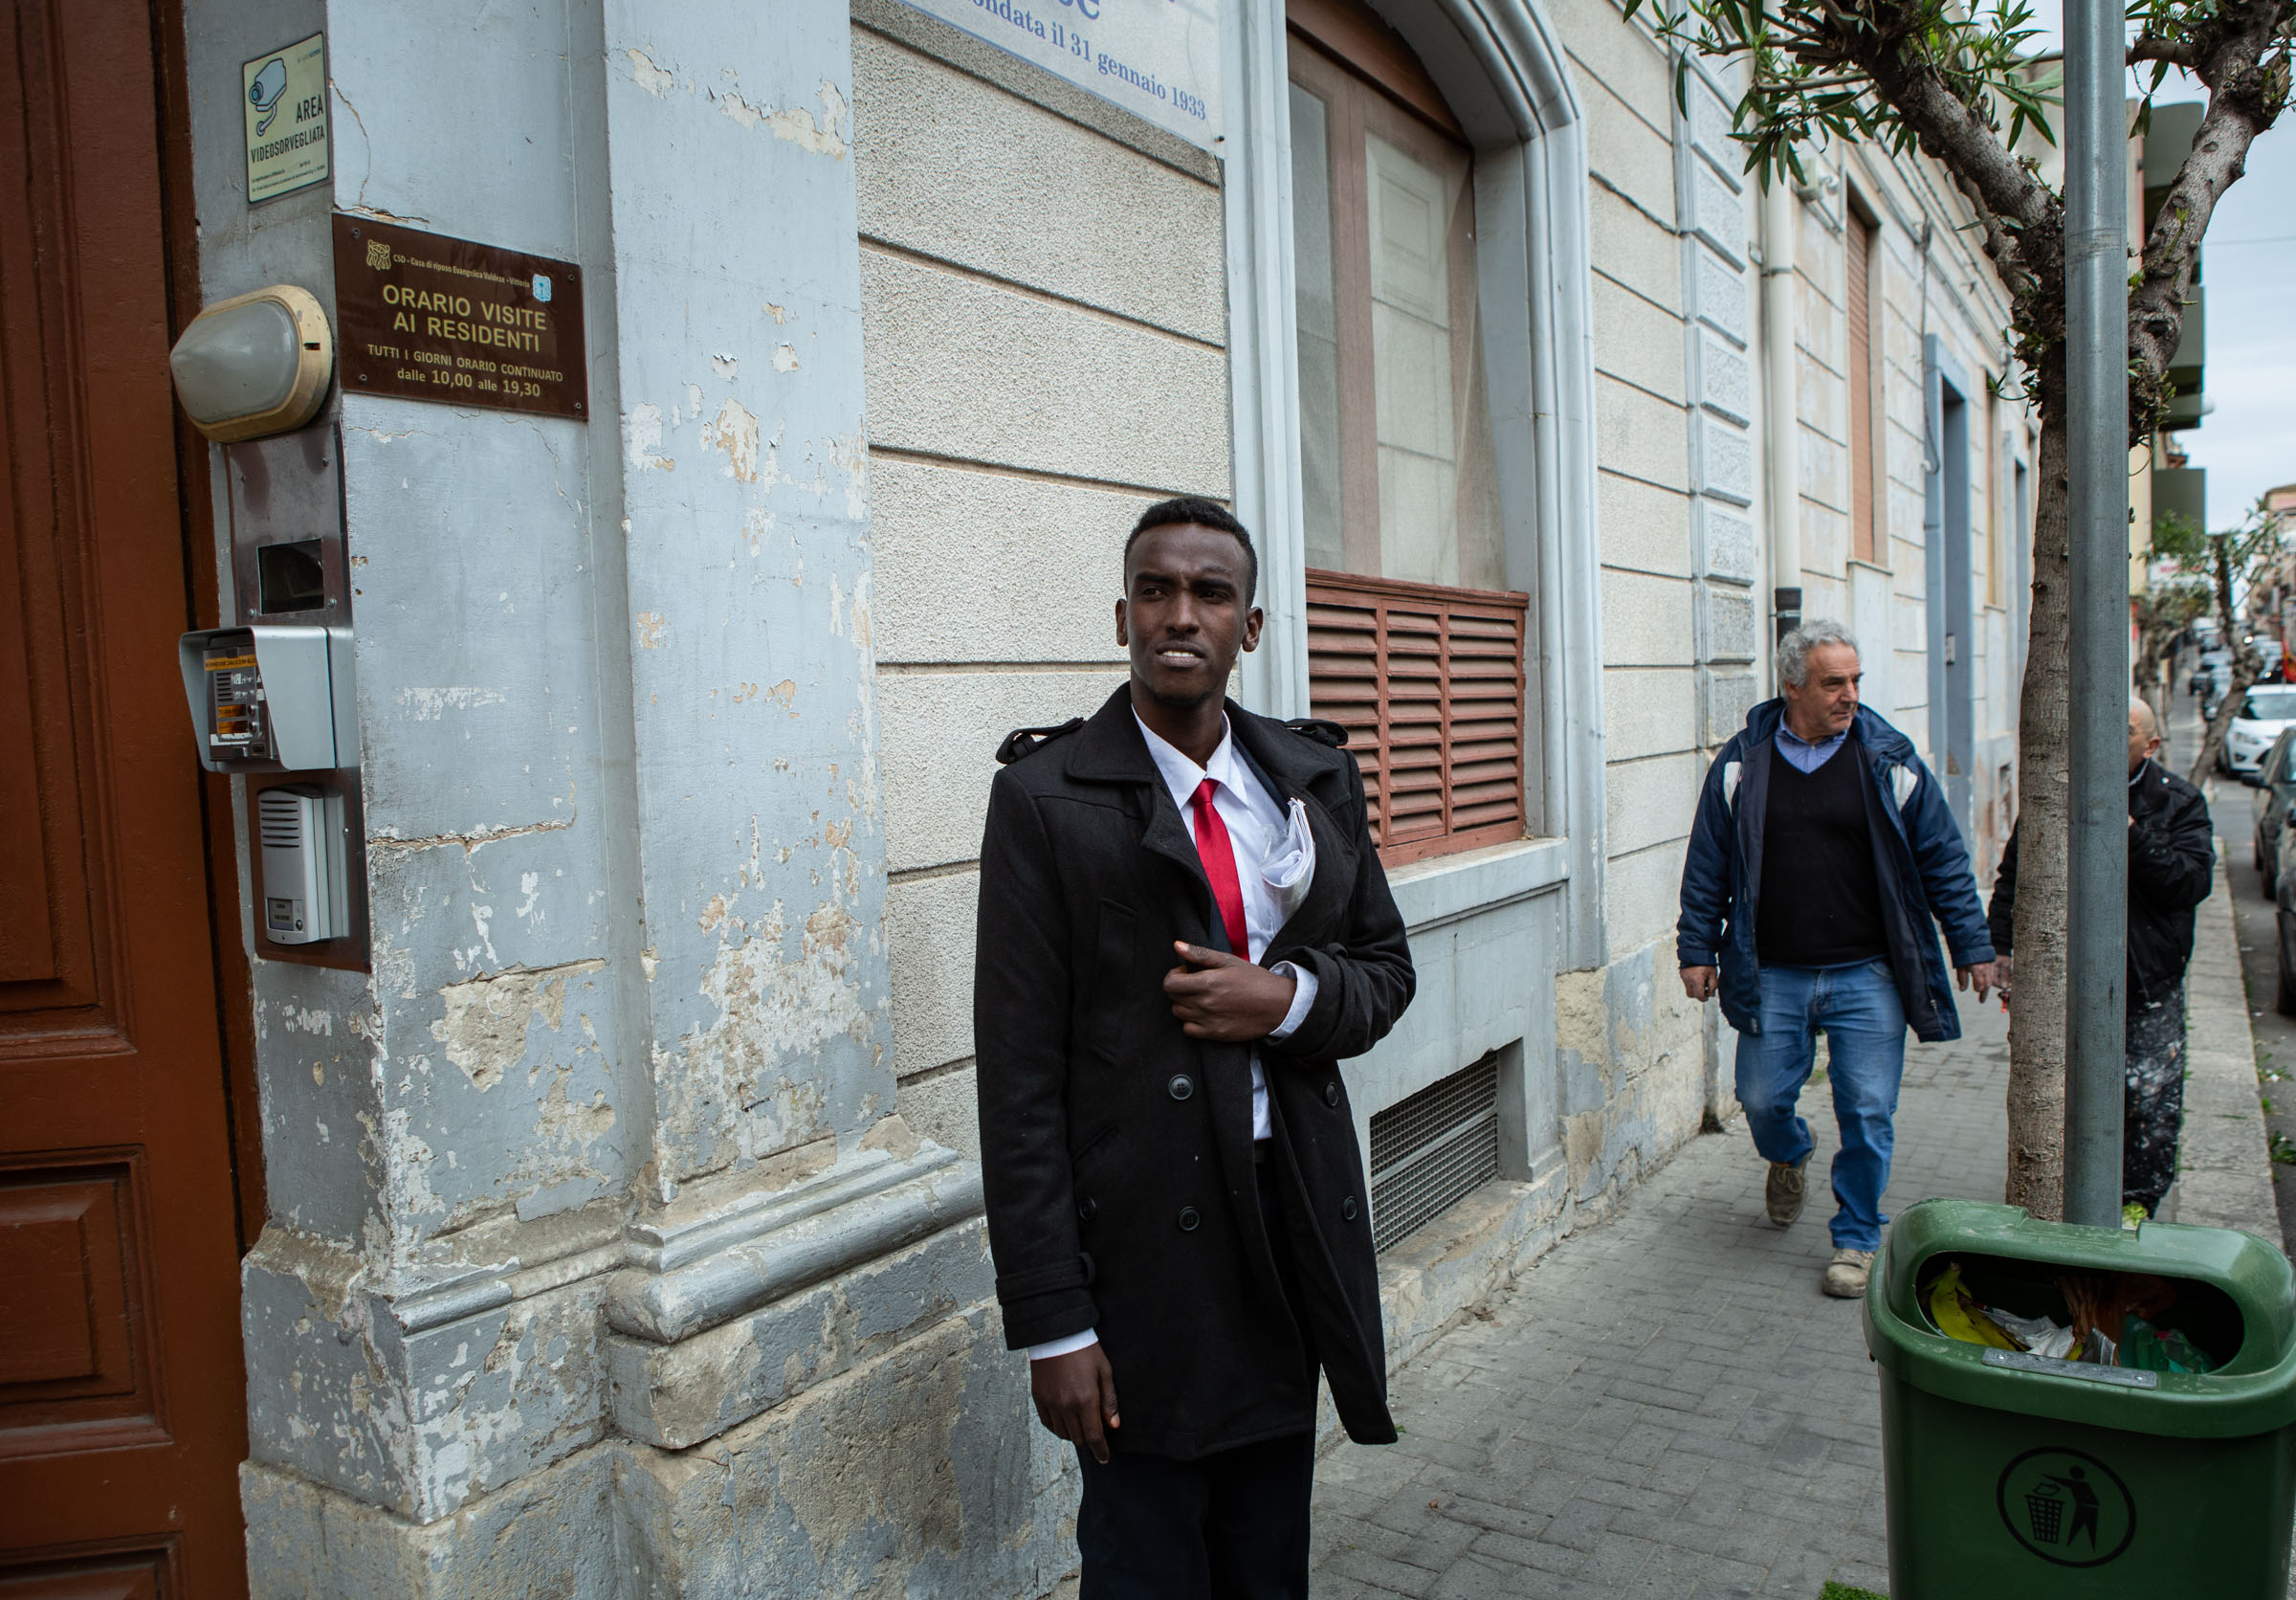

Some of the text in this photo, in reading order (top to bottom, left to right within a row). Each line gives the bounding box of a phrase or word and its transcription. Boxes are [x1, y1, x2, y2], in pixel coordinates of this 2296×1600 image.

[1051, 21, 1065, 49] il
[1071, 33, 1092, 62] 31
[1097, 53, 1166, 100] gennaio
[1172, 86, 1206, 121] 1933
[296, 94, 323, 123] AREA
[251, 125, 324, 164] VIDEOSORVEGLIATA
[393, 254, 406, 263] CSD
[410, 257, 425, 268] Casa
[426, 260, 432, 269] di
[433, 261, 452, 273] riposo
[453, 266, 483, 278] Evangelica
[483, 272, 505, 284] Valdese
[509, 277, 530, 288] Vittoria
[383, 284, 546, 330] ORARIO VISITE
[394, 311, 540, 352] AI RESIDENTI
[367, 344, 563, 382] TUTTI I GIORNI ORARIO CONTINUATO
[397, 367, 541, 397] dalle 10,00 alle 19,30
